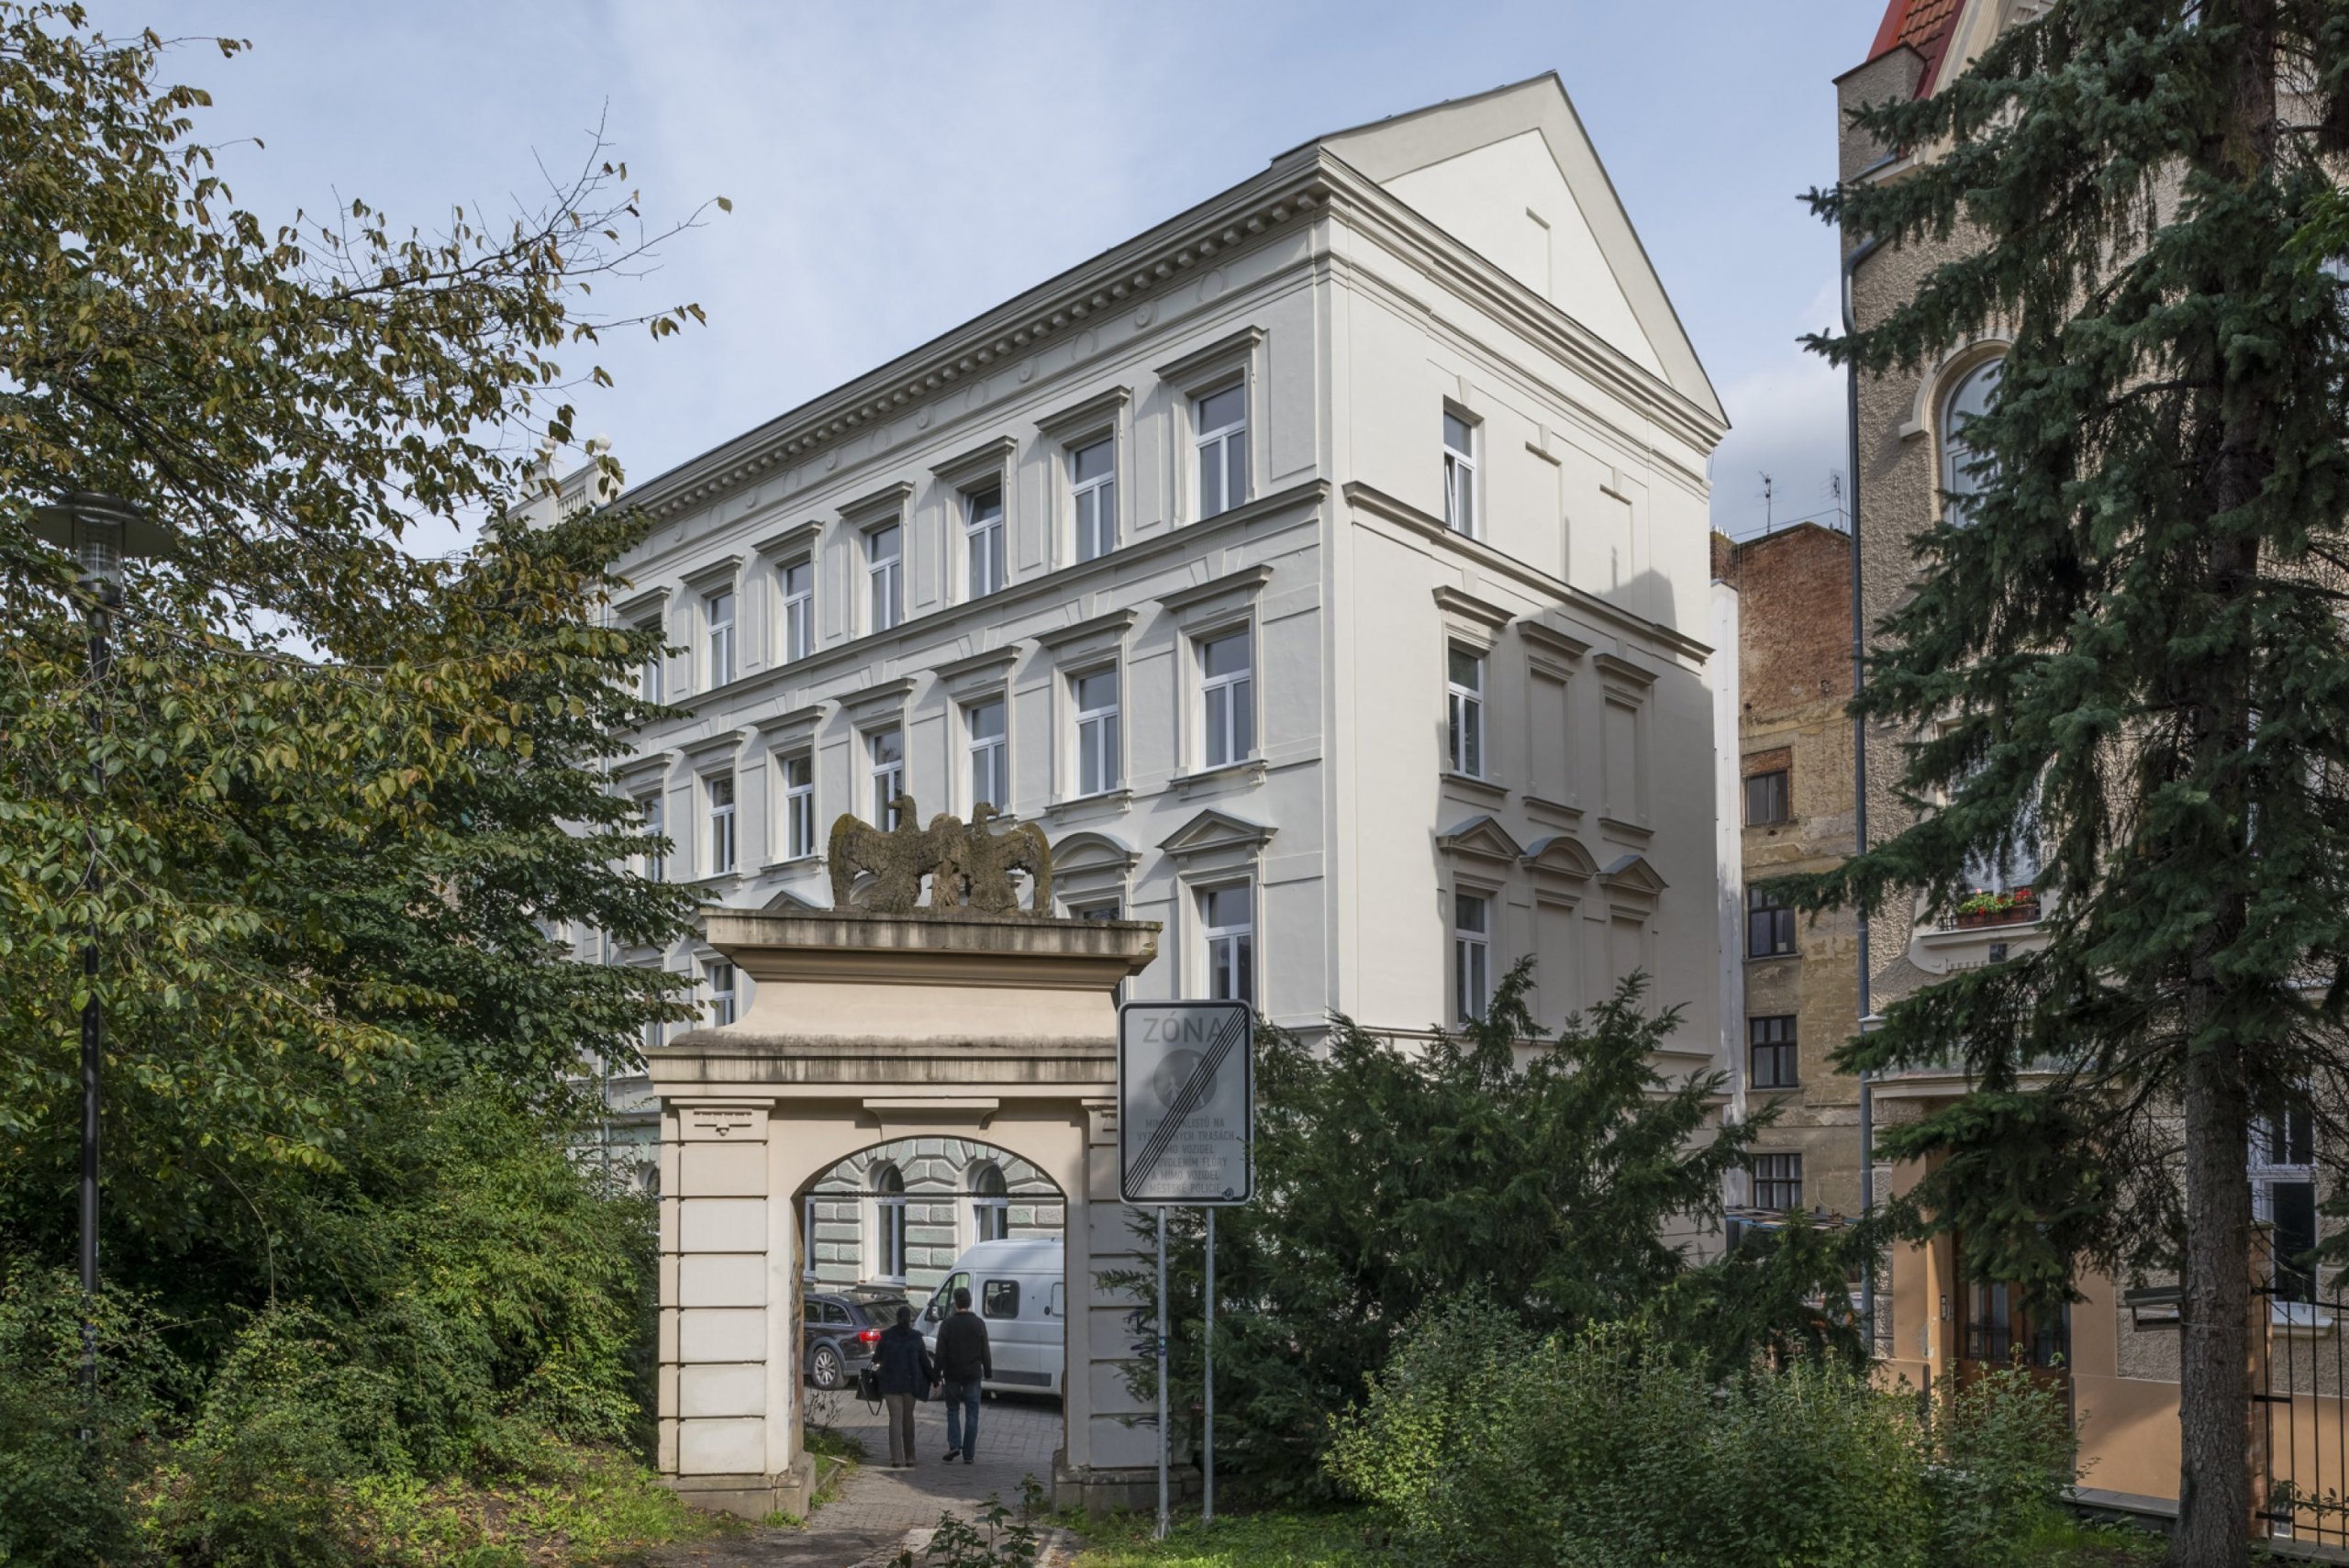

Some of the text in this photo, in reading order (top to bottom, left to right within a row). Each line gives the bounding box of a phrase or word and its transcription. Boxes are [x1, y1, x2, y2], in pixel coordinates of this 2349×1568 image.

[1142, 1011, 1226, 1043] ZÓNA
[1213, 1118, 1225, 1128] NA
[1182, 1144, 1215, 1154] VOZIDEL
[1188, 1170, 1219, 1180] VOZIDEL
[1190, 1184, 1221, 1194] POLICIE
